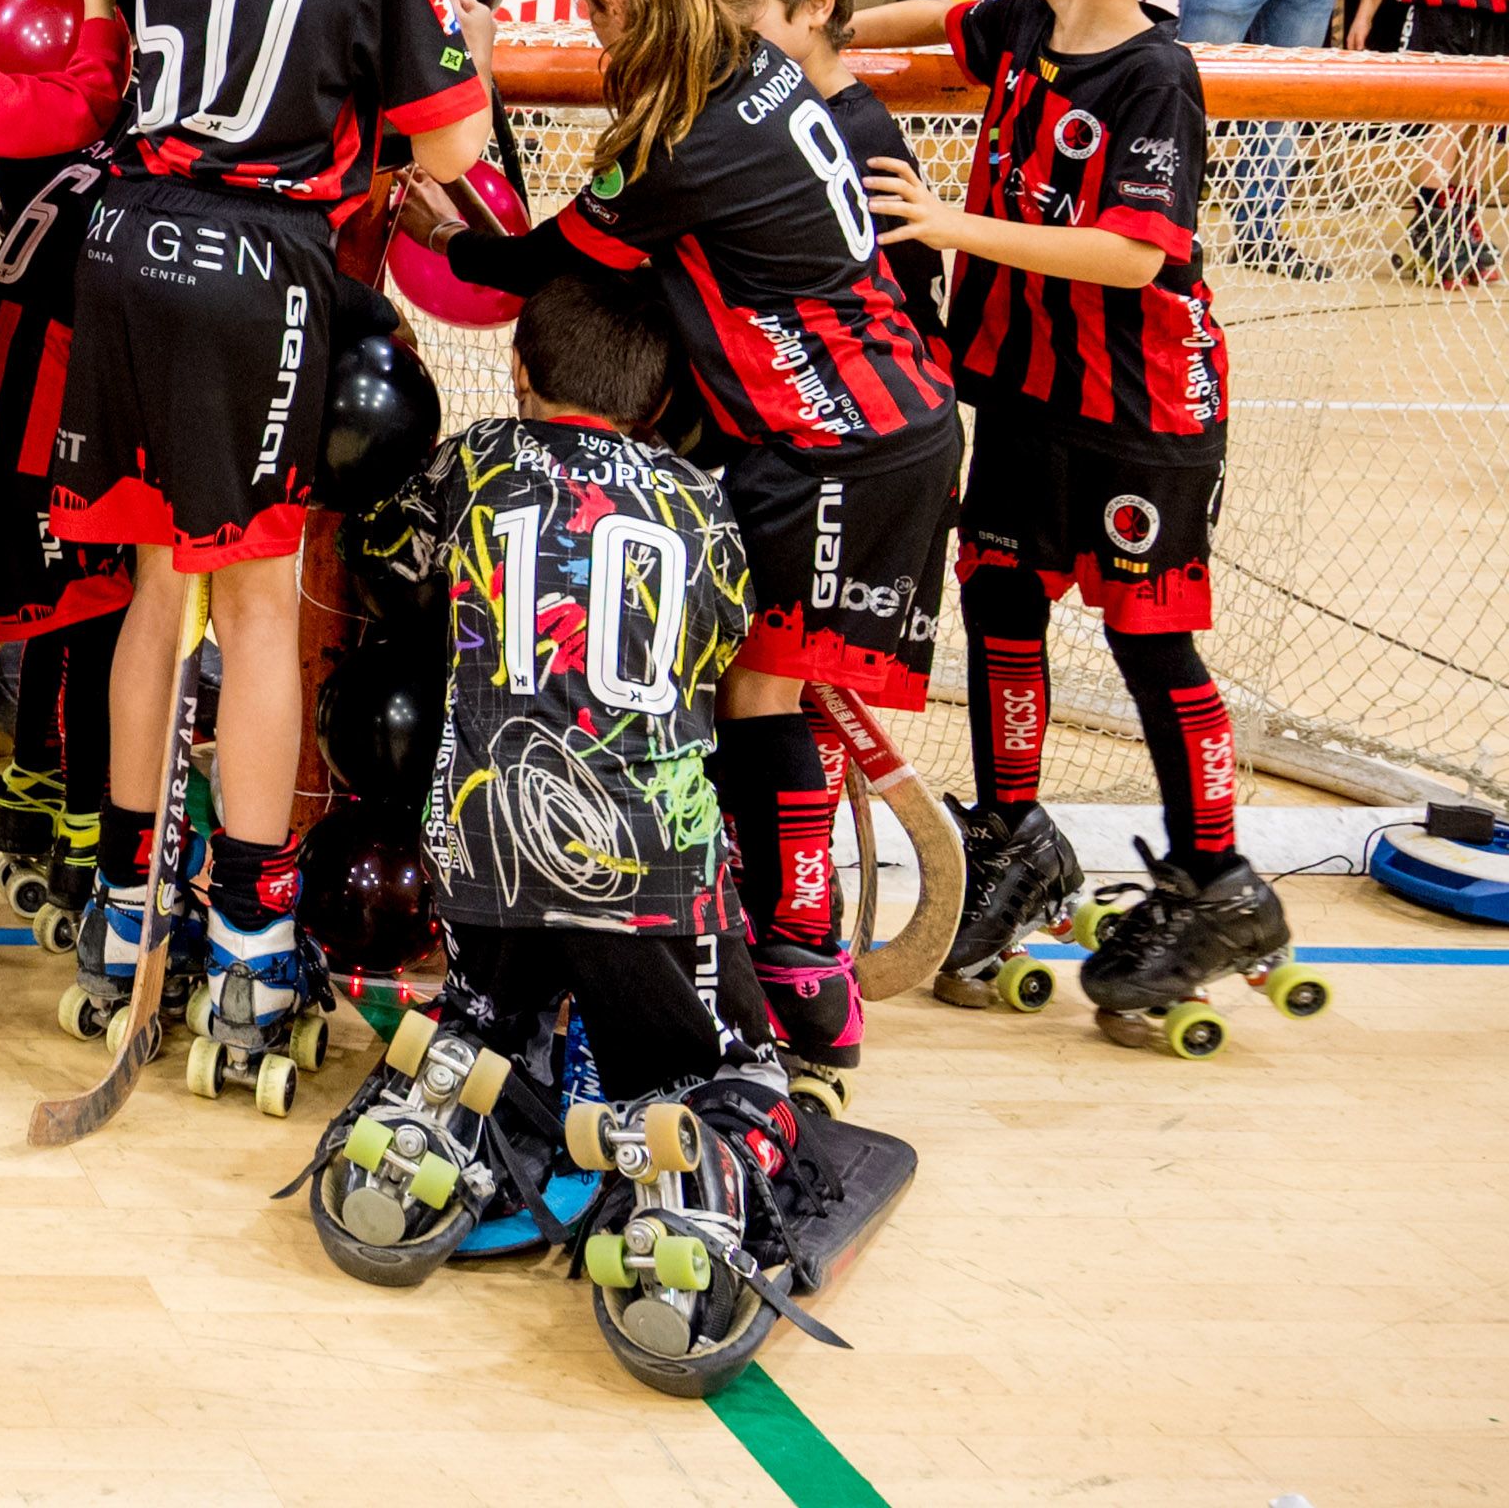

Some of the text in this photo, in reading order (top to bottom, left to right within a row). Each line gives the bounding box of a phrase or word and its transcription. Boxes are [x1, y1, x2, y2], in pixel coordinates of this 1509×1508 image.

[737, 57, 804, 125] CANDELA
[752, 49, 770, 77] 1967
[789, 99, 877, 263] 8
[87, 248, 197, 286] DATA CENTER
[745, 314, 809, 371] Cugat
[783, 364, 835, 418] Sant
[836, 394, 865, 430] hotel
[577, 432, 622, 458] 1967
[492, 505, 687, 715] 10
[1003, 687, 1037, 752] PHCSC
[164, 695, 198, 871] SPARTAN
[1204, 731, 1233, 802] PHCSC
[791, 847, 825, 910] PHCSC
